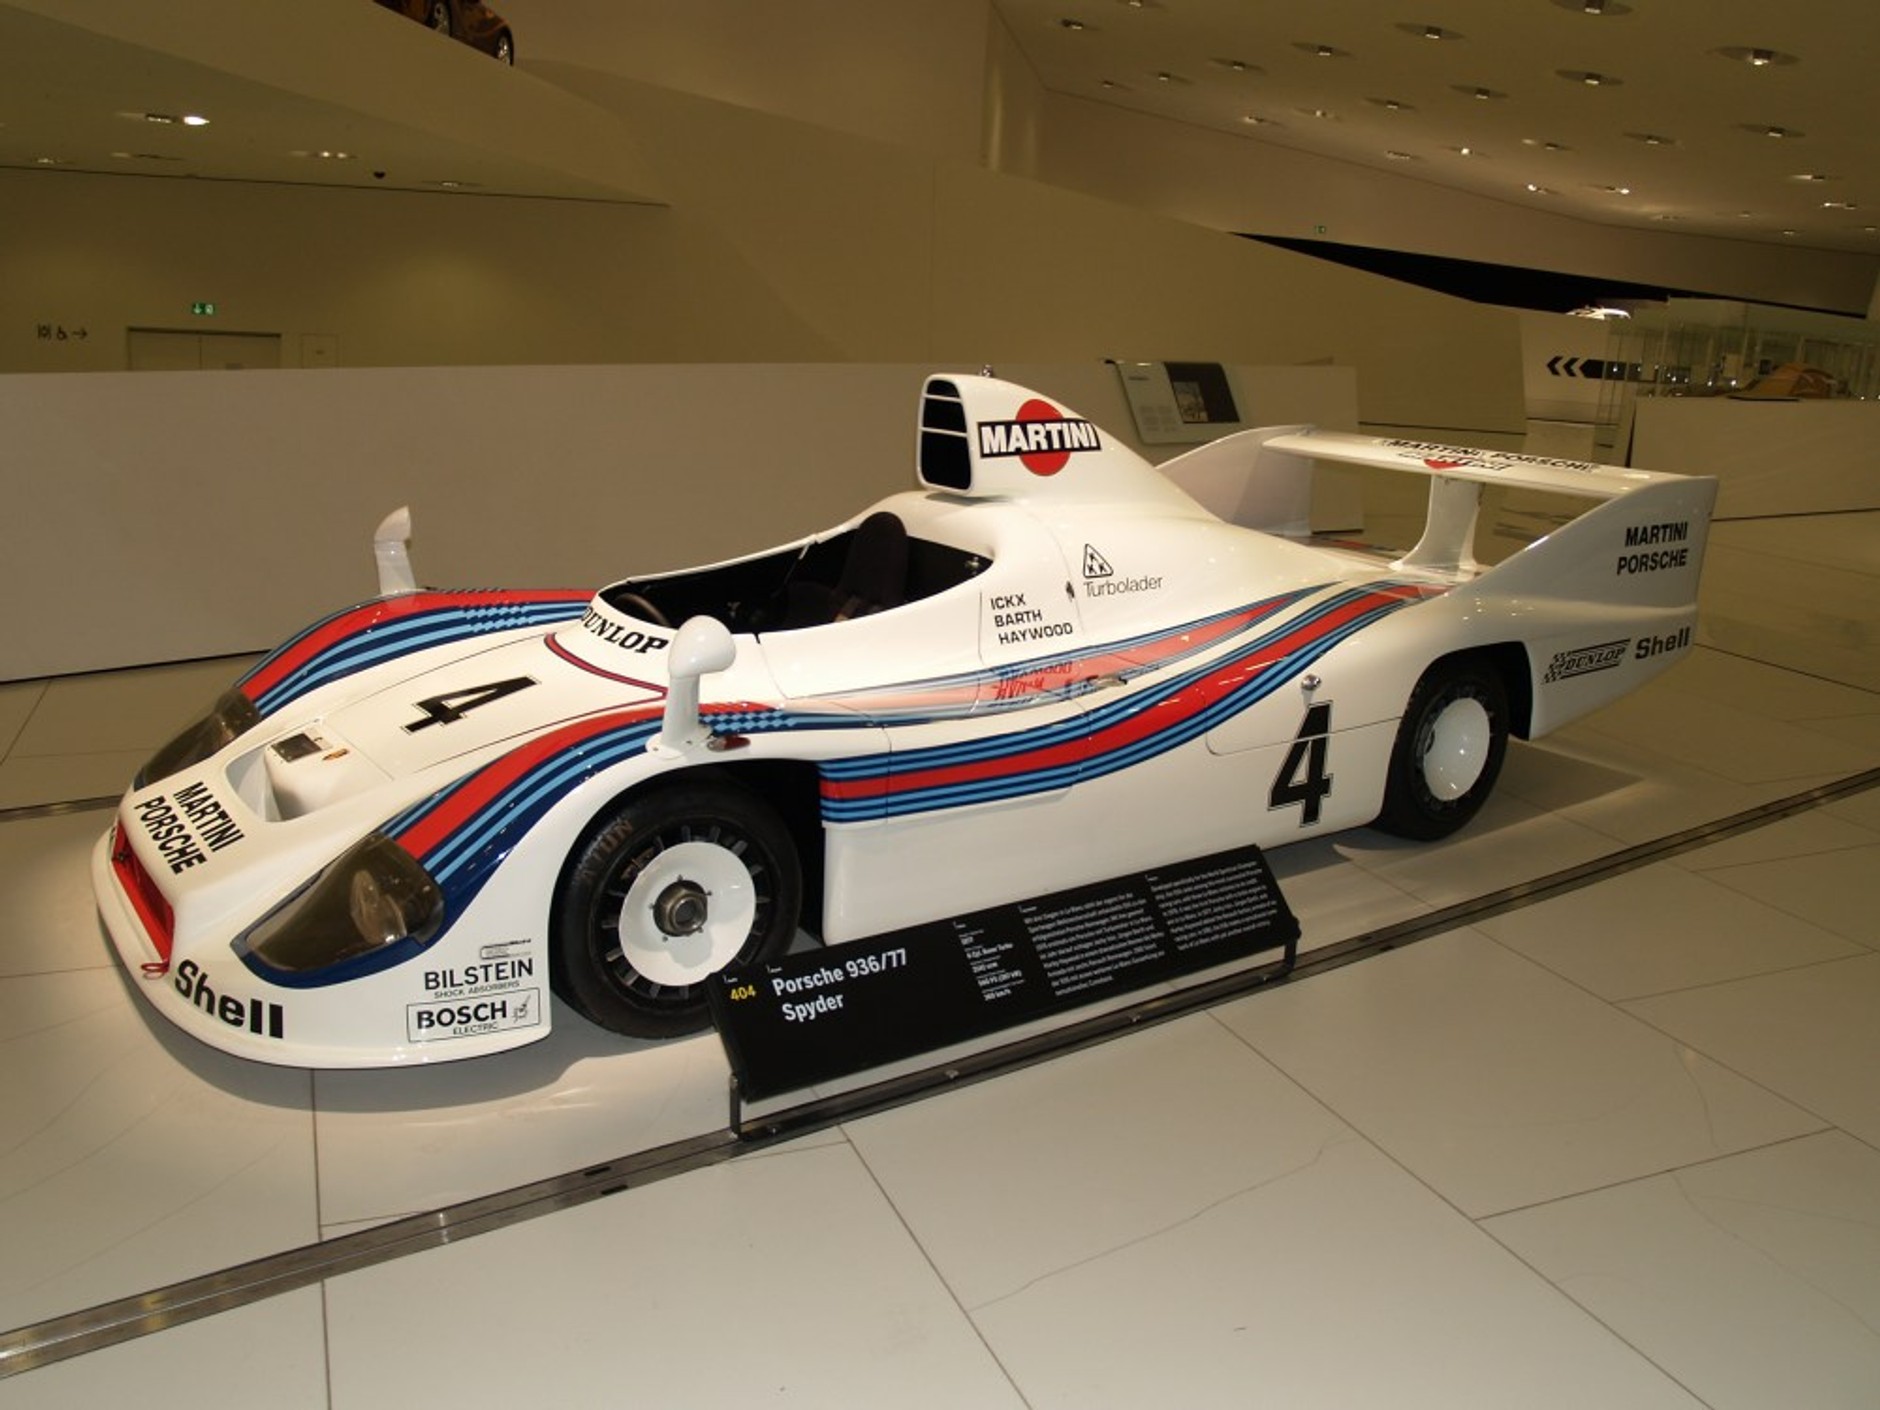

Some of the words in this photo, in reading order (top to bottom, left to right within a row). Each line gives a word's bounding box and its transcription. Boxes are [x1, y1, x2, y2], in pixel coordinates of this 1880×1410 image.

[980, 423, 1098, 455] MARTINI
[1625, 522, 1688, 547] MARTINI
[1616, 549, 1689, 576] PORSCHE
[1083, 576, 1163, 598] Turbolader
[990, 593, 1026, 611] ICKX
[581, 606, 669, 654] DUNLOP
[994, 610, 1042, 627] BARTH
[998, 622, 1073, 645] HAYWOOD
[1635, 627, 1691, 660] Shell
[1564, 647, 1627, 672] DUNLOP
[401, 675, 540, 733] 4
[1268, 700, 1334, 828] 4
[173, 781, 245, 852] MARTINI
[134, 795, 207, 875] PORSCHE
[424, 958, 533, 990] BILSTEIN
[772, 967, 844, 996] Porsche
[845, 948, 907, 978] 936/77
[174, 959, 284, 1039] Shell
[434, 989, 465, 999] SHOCK
[468, 980, 520, 995] ABSORBERS
[730, 985, 757, 1001] 404
[417, 1000, 507, 1029] BOSCH
[782, 994, 844, 1022] Spyder
[453, 1021, 498, 1035] ELECTRIC
